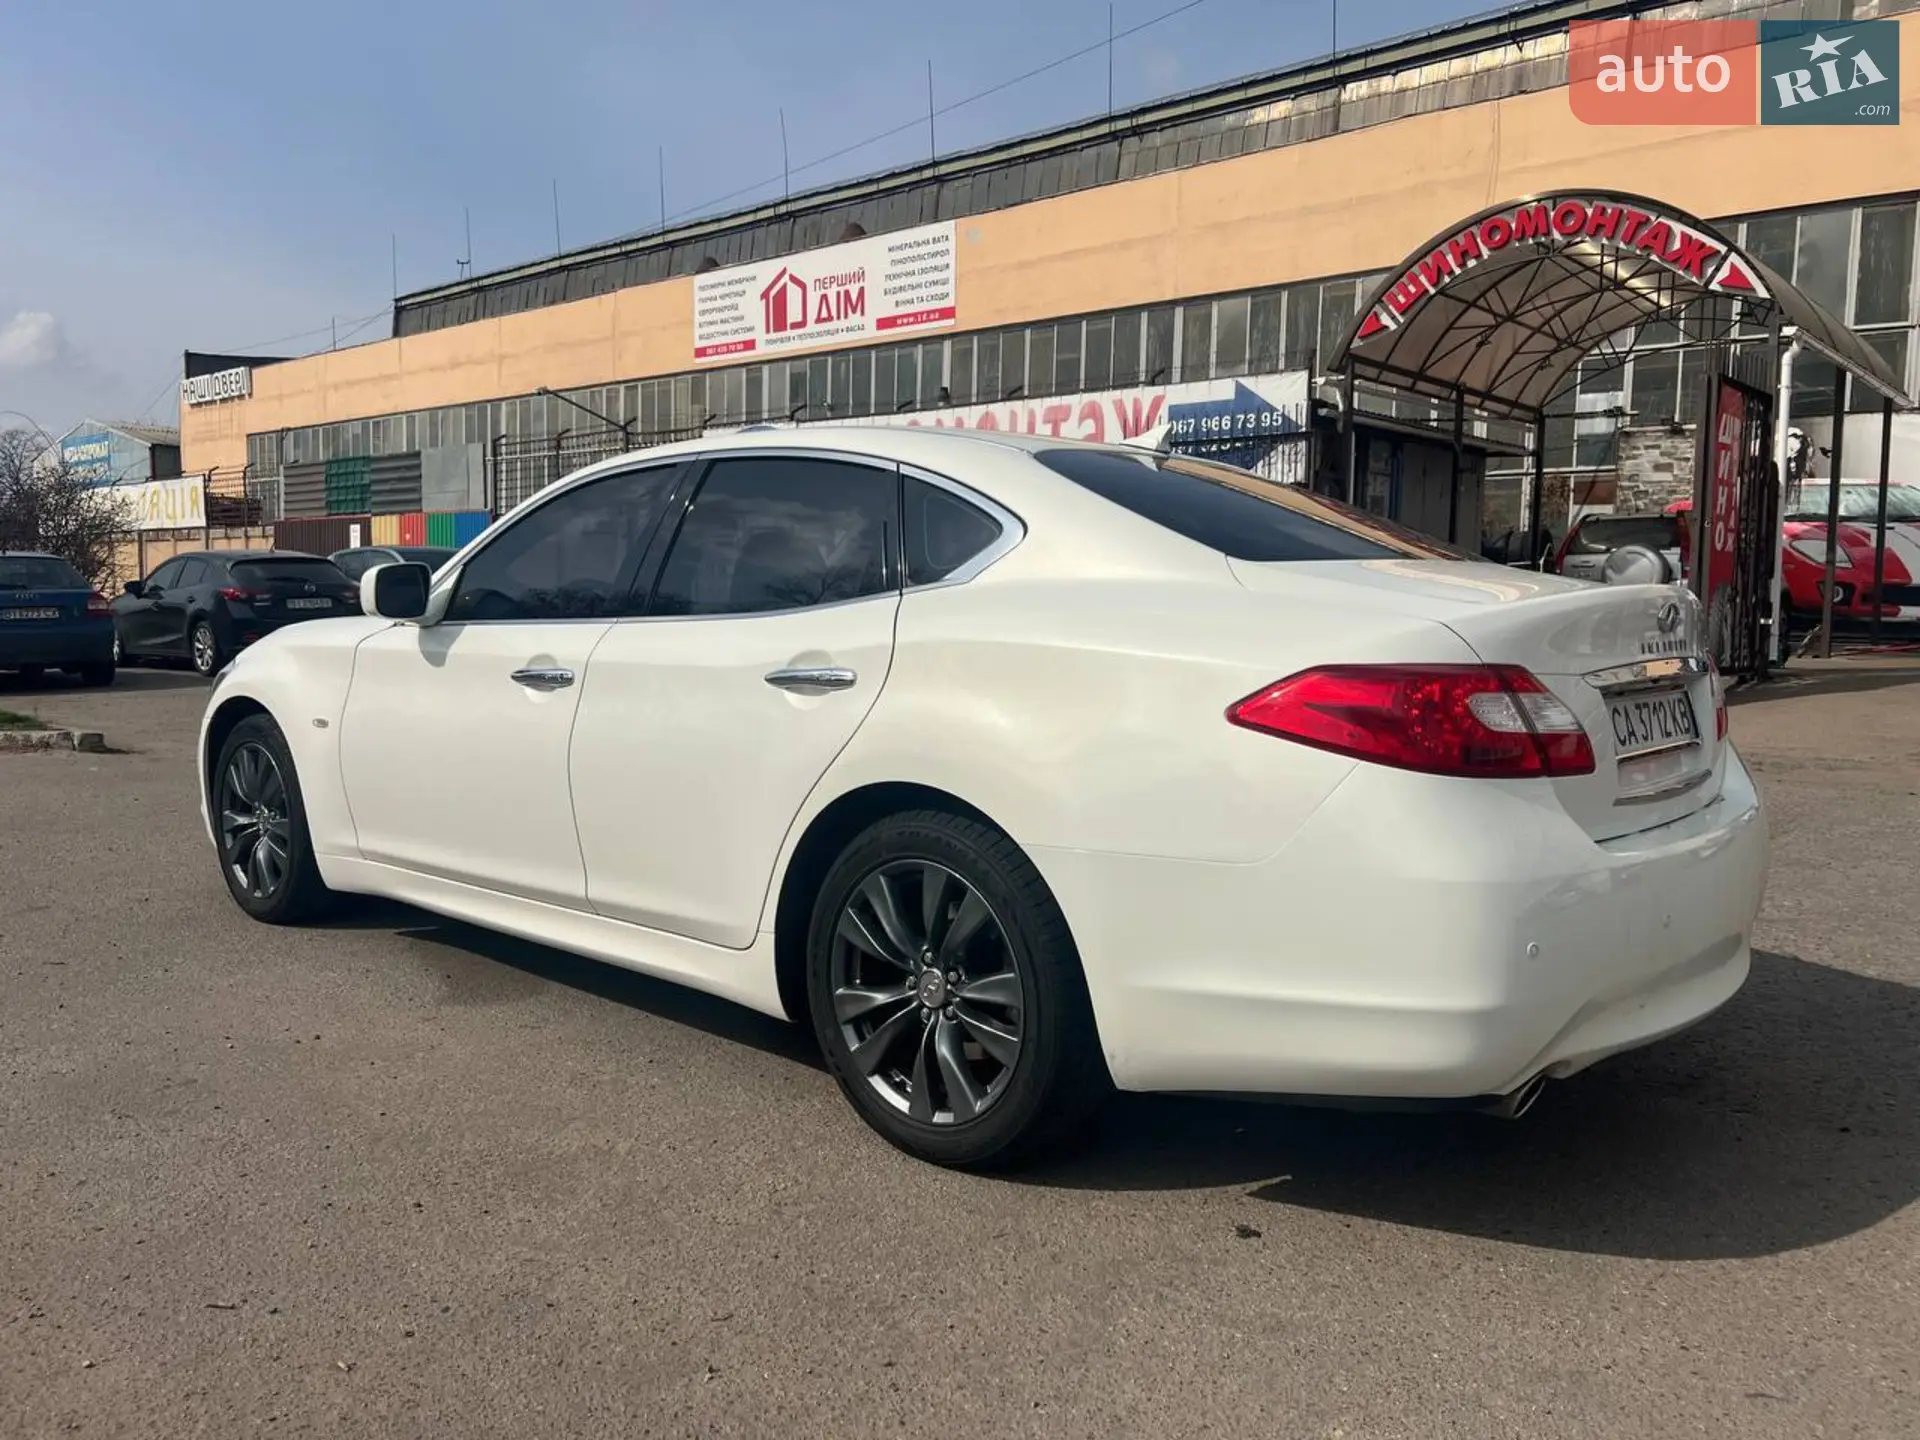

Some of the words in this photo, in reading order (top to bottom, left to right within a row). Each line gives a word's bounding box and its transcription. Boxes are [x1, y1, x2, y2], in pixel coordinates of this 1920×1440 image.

[932, 234, 950, 245] ВАТА
[1382, 200, 1719, 311] ШИНОМОНТАЖ
[813, 266, 866, 292] ПЕРШИЙ
[814, 286, 866, 325] ДІМ
[182, 377, 210, 401] НАШІ
[213, 370, 246, 398] ДВЕРІ
[1201, 415, 1232, 432] 966
[1236, 413, 1256, 429] 73
[1261, 411, 1283, 427] 95
[1715, 413, 1733, 551] ШИНО
